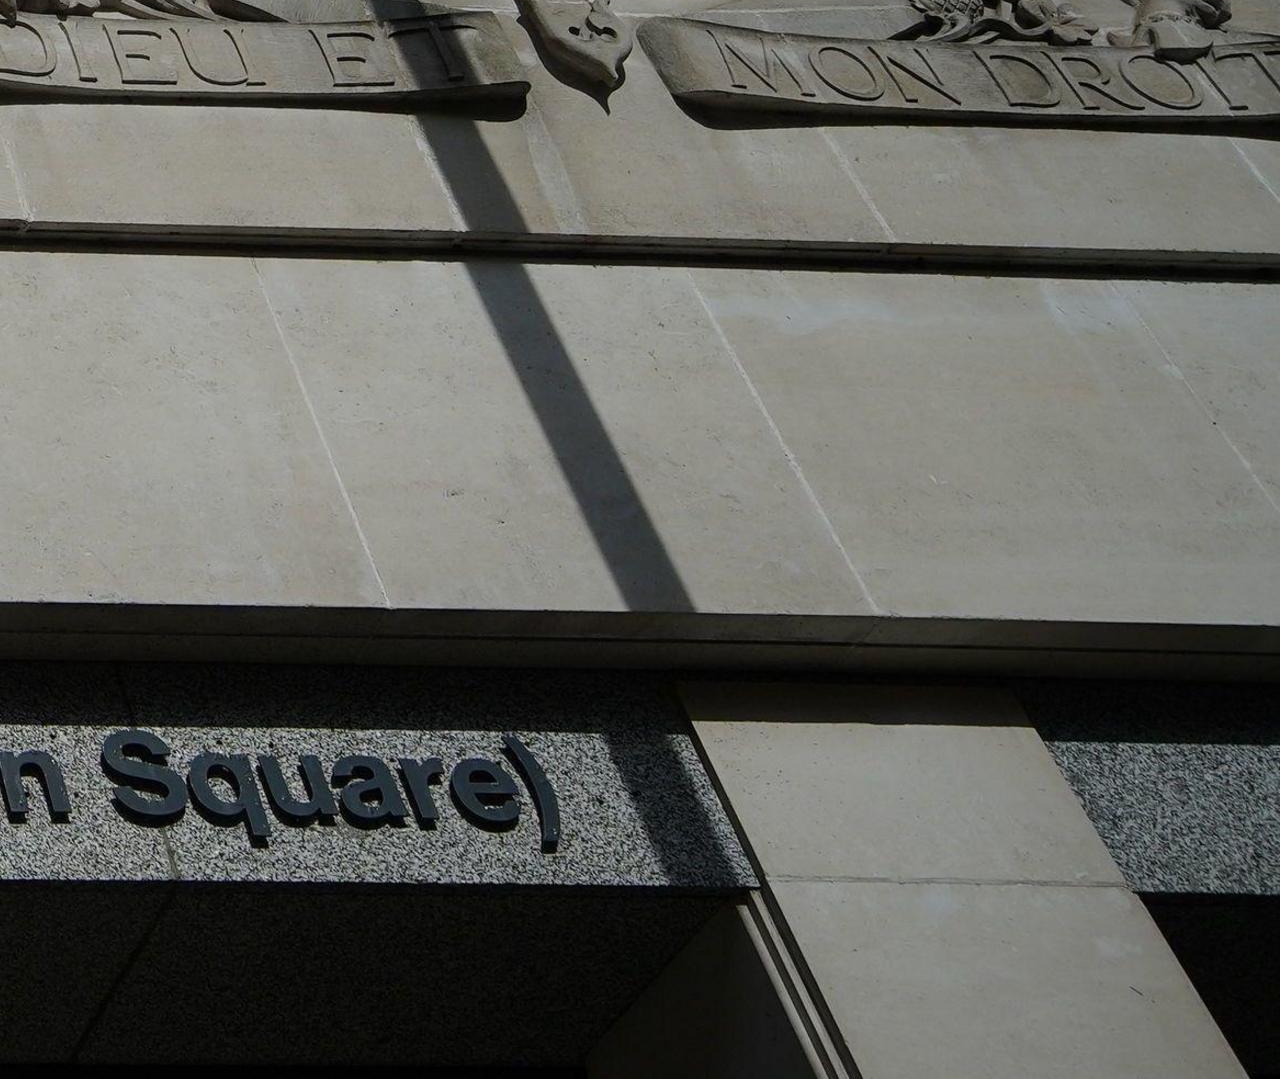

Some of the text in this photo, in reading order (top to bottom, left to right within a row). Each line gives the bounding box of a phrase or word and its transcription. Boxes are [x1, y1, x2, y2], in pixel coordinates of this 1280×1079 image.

[308, 24, 478, 88] ET
[706, 29, 961, 107] MON
[101, 728, 561, 852] Square)
